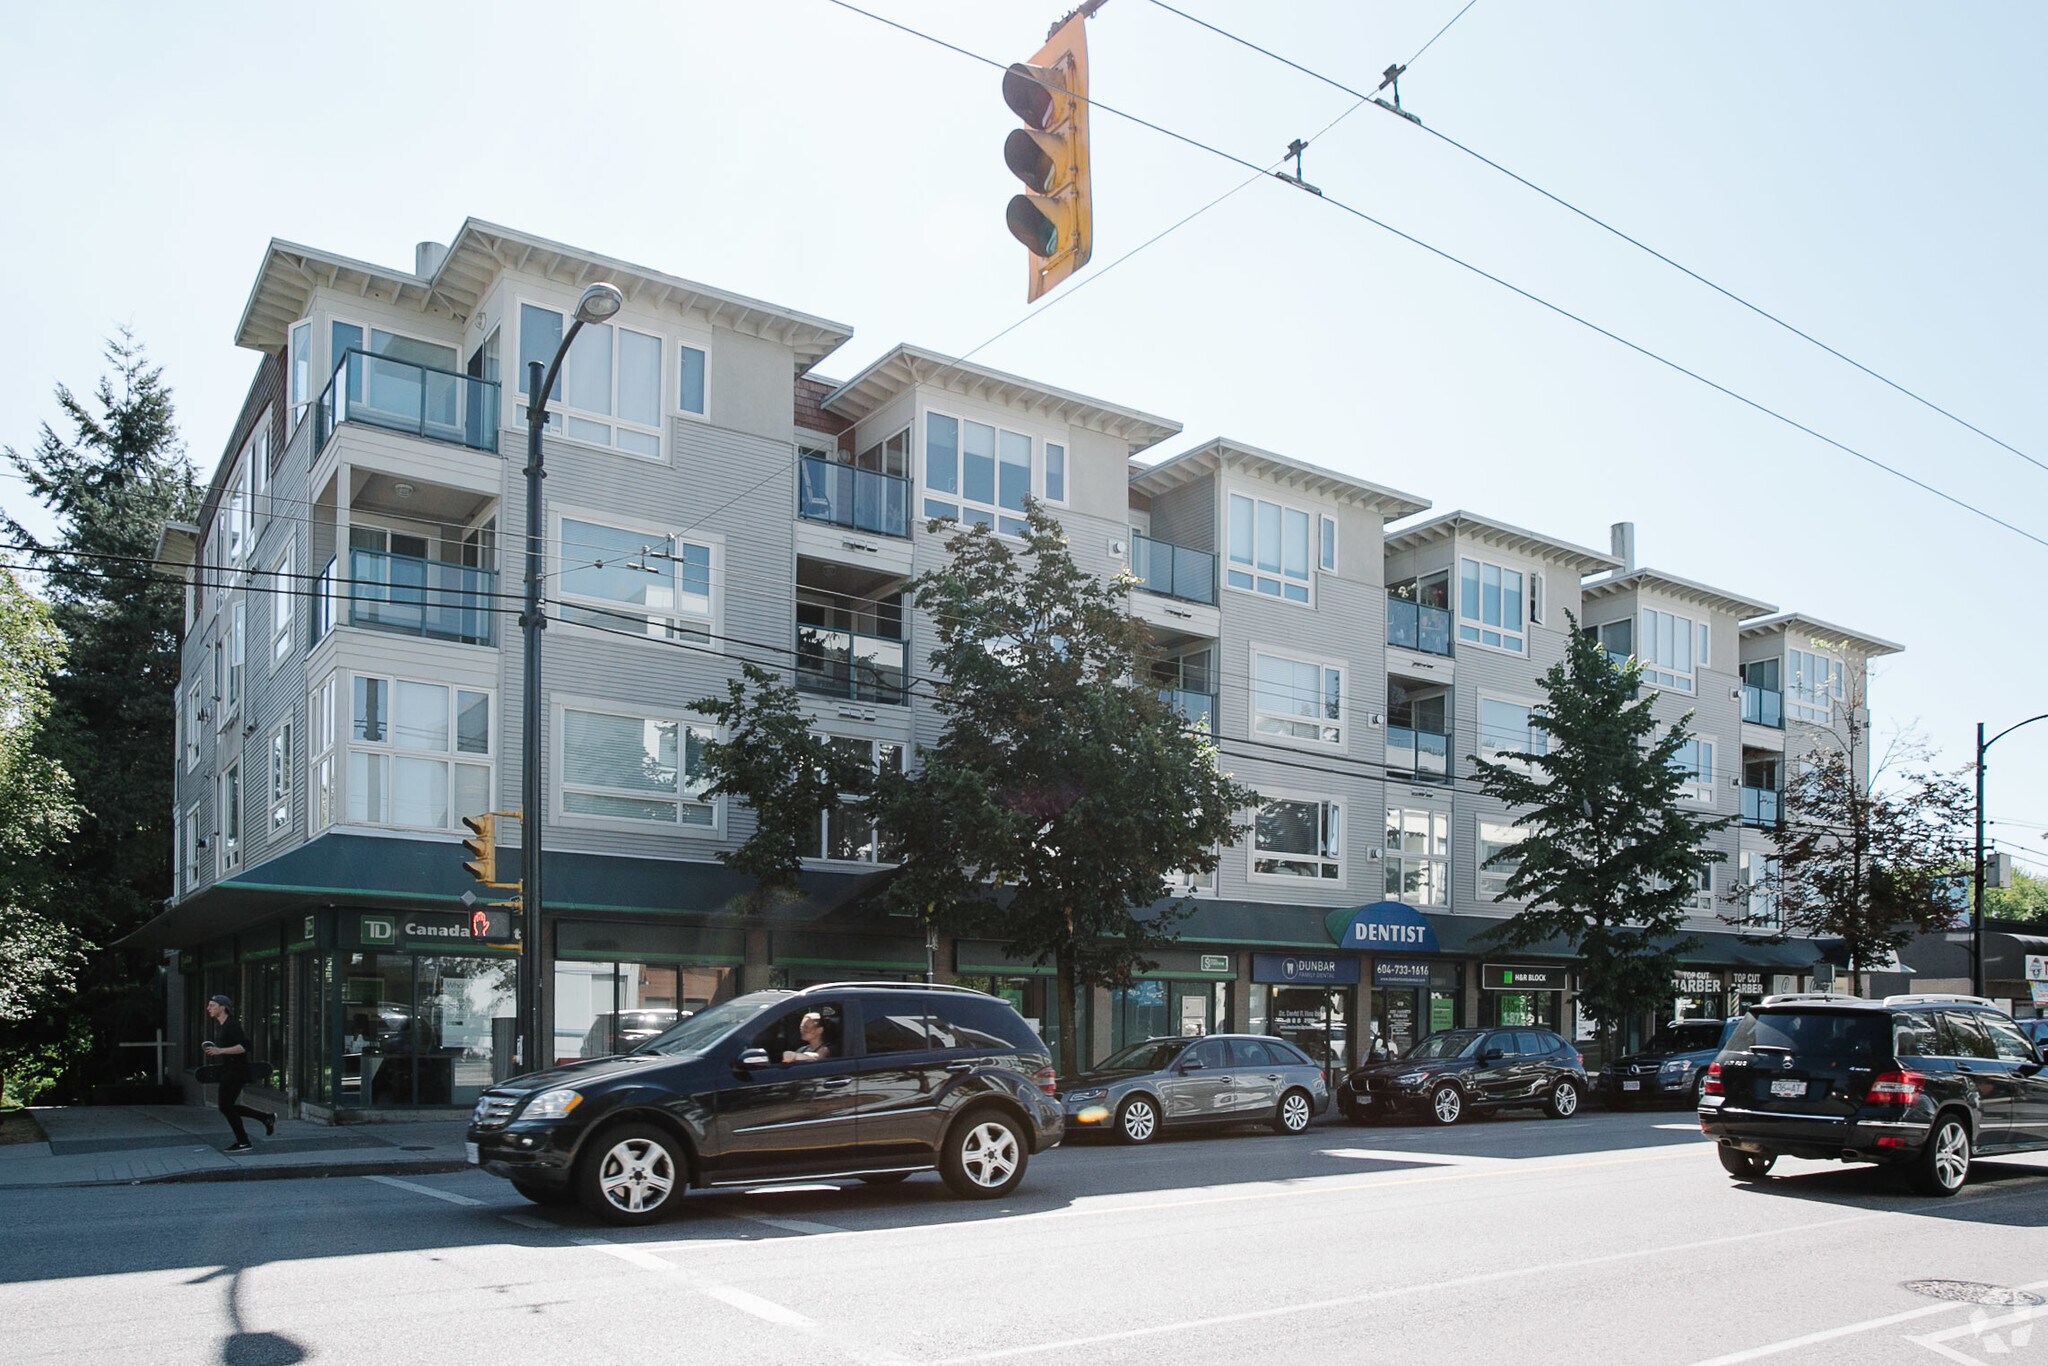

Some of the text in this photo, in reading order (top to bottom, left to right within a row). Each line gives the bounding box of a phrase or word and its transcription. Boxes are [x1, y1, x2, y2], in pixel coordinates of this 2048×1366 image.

[364, 920, 471, 939] TD Canada
[1355, 922, 1426, 943] DENTIST
[1298, 960, 1335, 972] DUNBAR
[1377, 964, 1429, 976] 604-733-1616
[1514, 973, 1547, 982] H&R BLOCK
[1682, 971, 1710, 980] TOP CUT
[1733, 973, 1761, 983] TOP CUT
